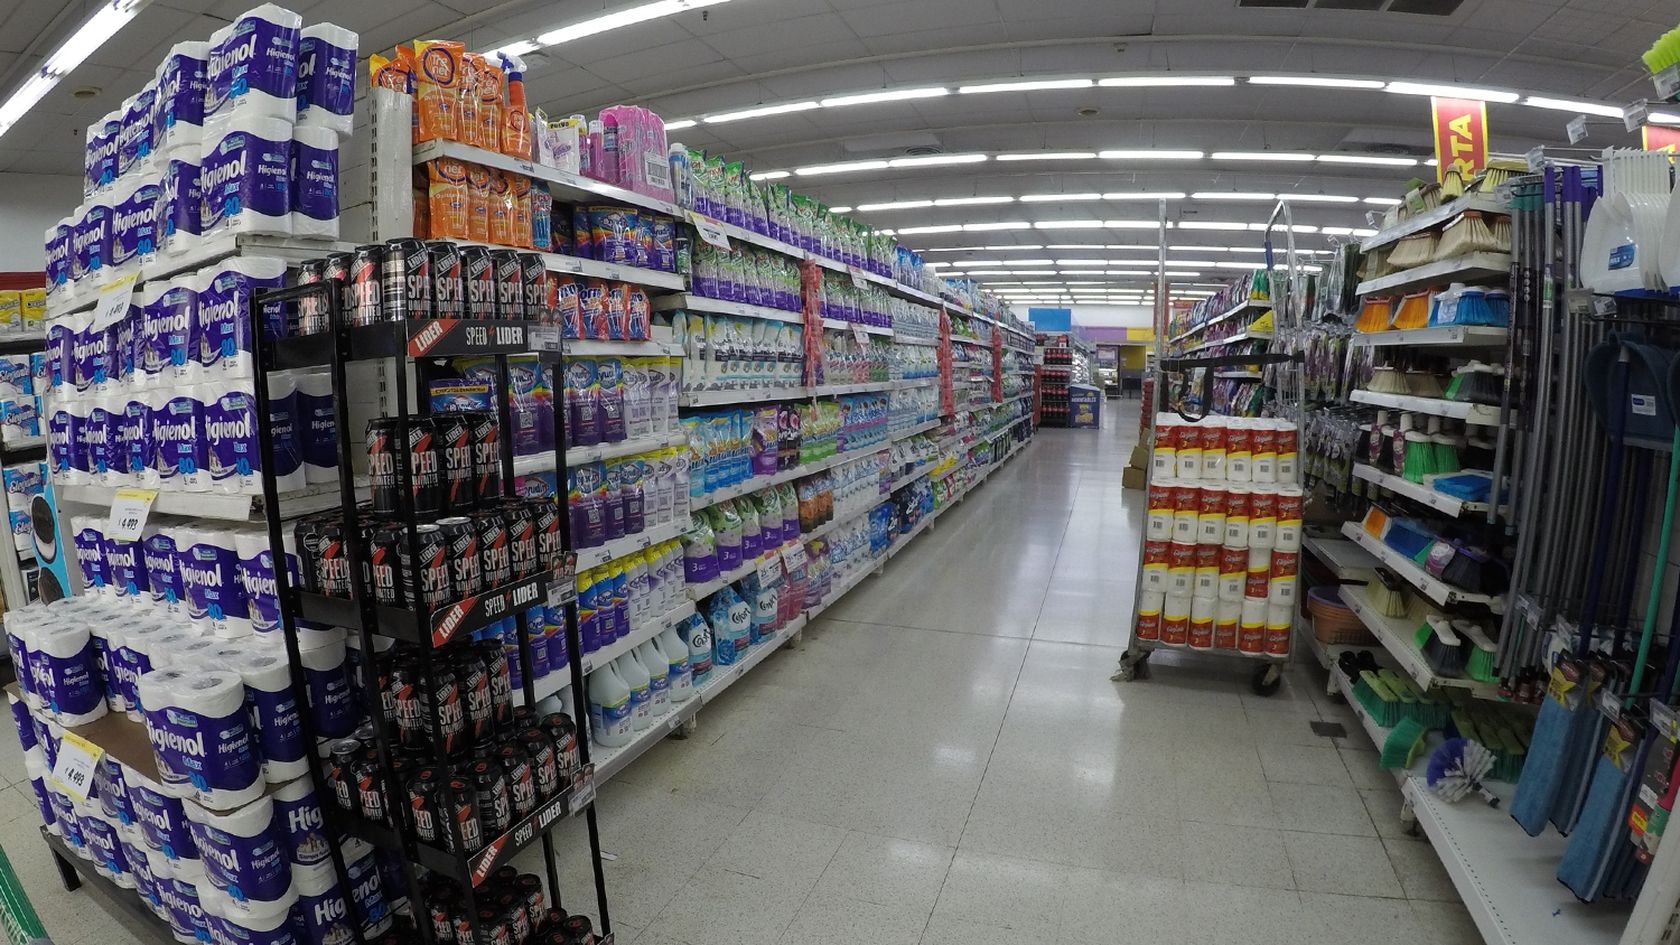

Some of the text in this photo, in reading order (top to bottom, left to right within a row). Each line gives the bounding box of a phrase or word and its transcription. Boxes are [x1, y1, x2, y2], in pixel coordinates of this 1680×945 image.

[414, 320, 444, 352] LIDER
[466, 326, 487, 345] SPEED
[496, 326, 523, 345] LIDER
[271, 423, 293, 438] gienol
[311, 420, 335, 431] Higien
[410, 451, 438, 475] PEED
[744, 540, 750, 550] 3
[765, 531, 770, 540] 3
[723, 551, 729, 561] 3
[692, 563, 698, 572] 3
[241, 566, 277, 599] Higien
[485, 594, 505, 617] SPEED
[512, 582, 539, 606] LIDER
[438, 605, 465, 639] LIDER
[514, 801, 562, 848] SPEED LIDER
[475, 844, 499, 879] LIDER
